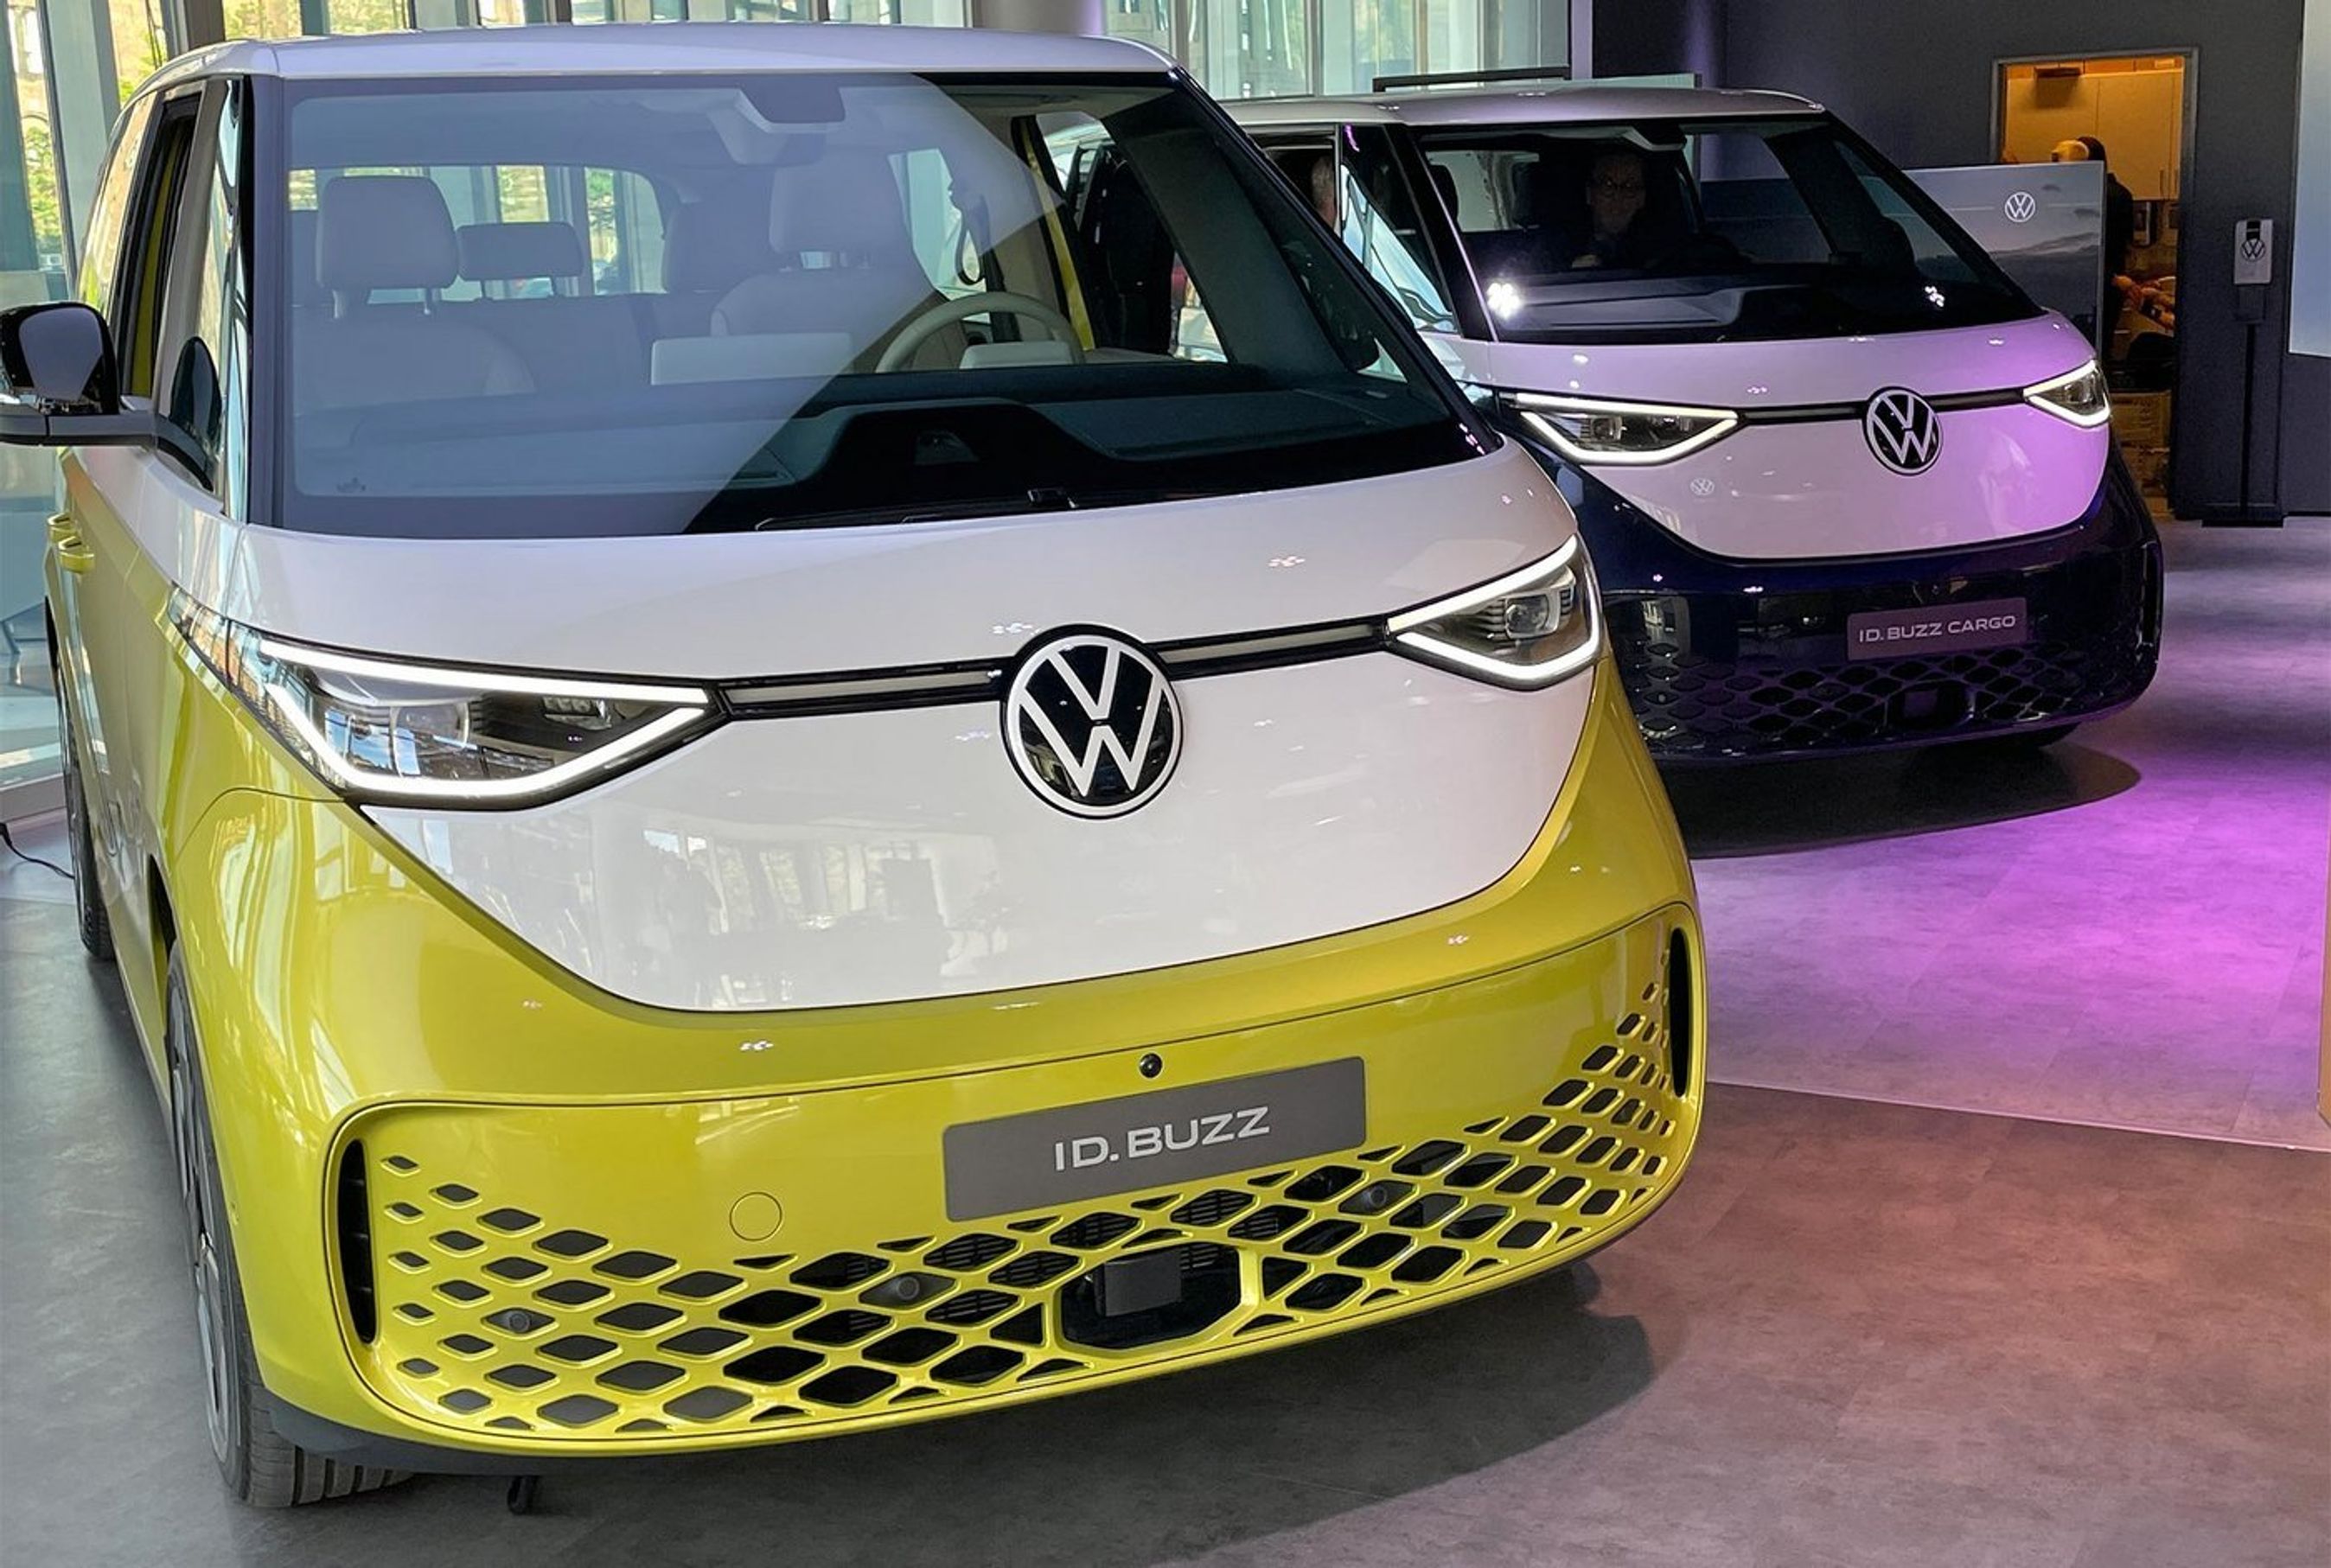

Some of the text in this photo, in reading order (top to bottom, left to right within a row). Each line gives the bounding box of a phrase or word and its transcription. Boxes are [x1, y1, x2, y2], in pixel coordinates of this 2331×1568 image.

[2006, 192, 2034, 220] VW
[2241, 239, 2265, 259] VW
[1868, 391, 1939, 469] VW
[1947, 615, 2016, 634] CARGO
[1012, 637, 1175, 808] VW
